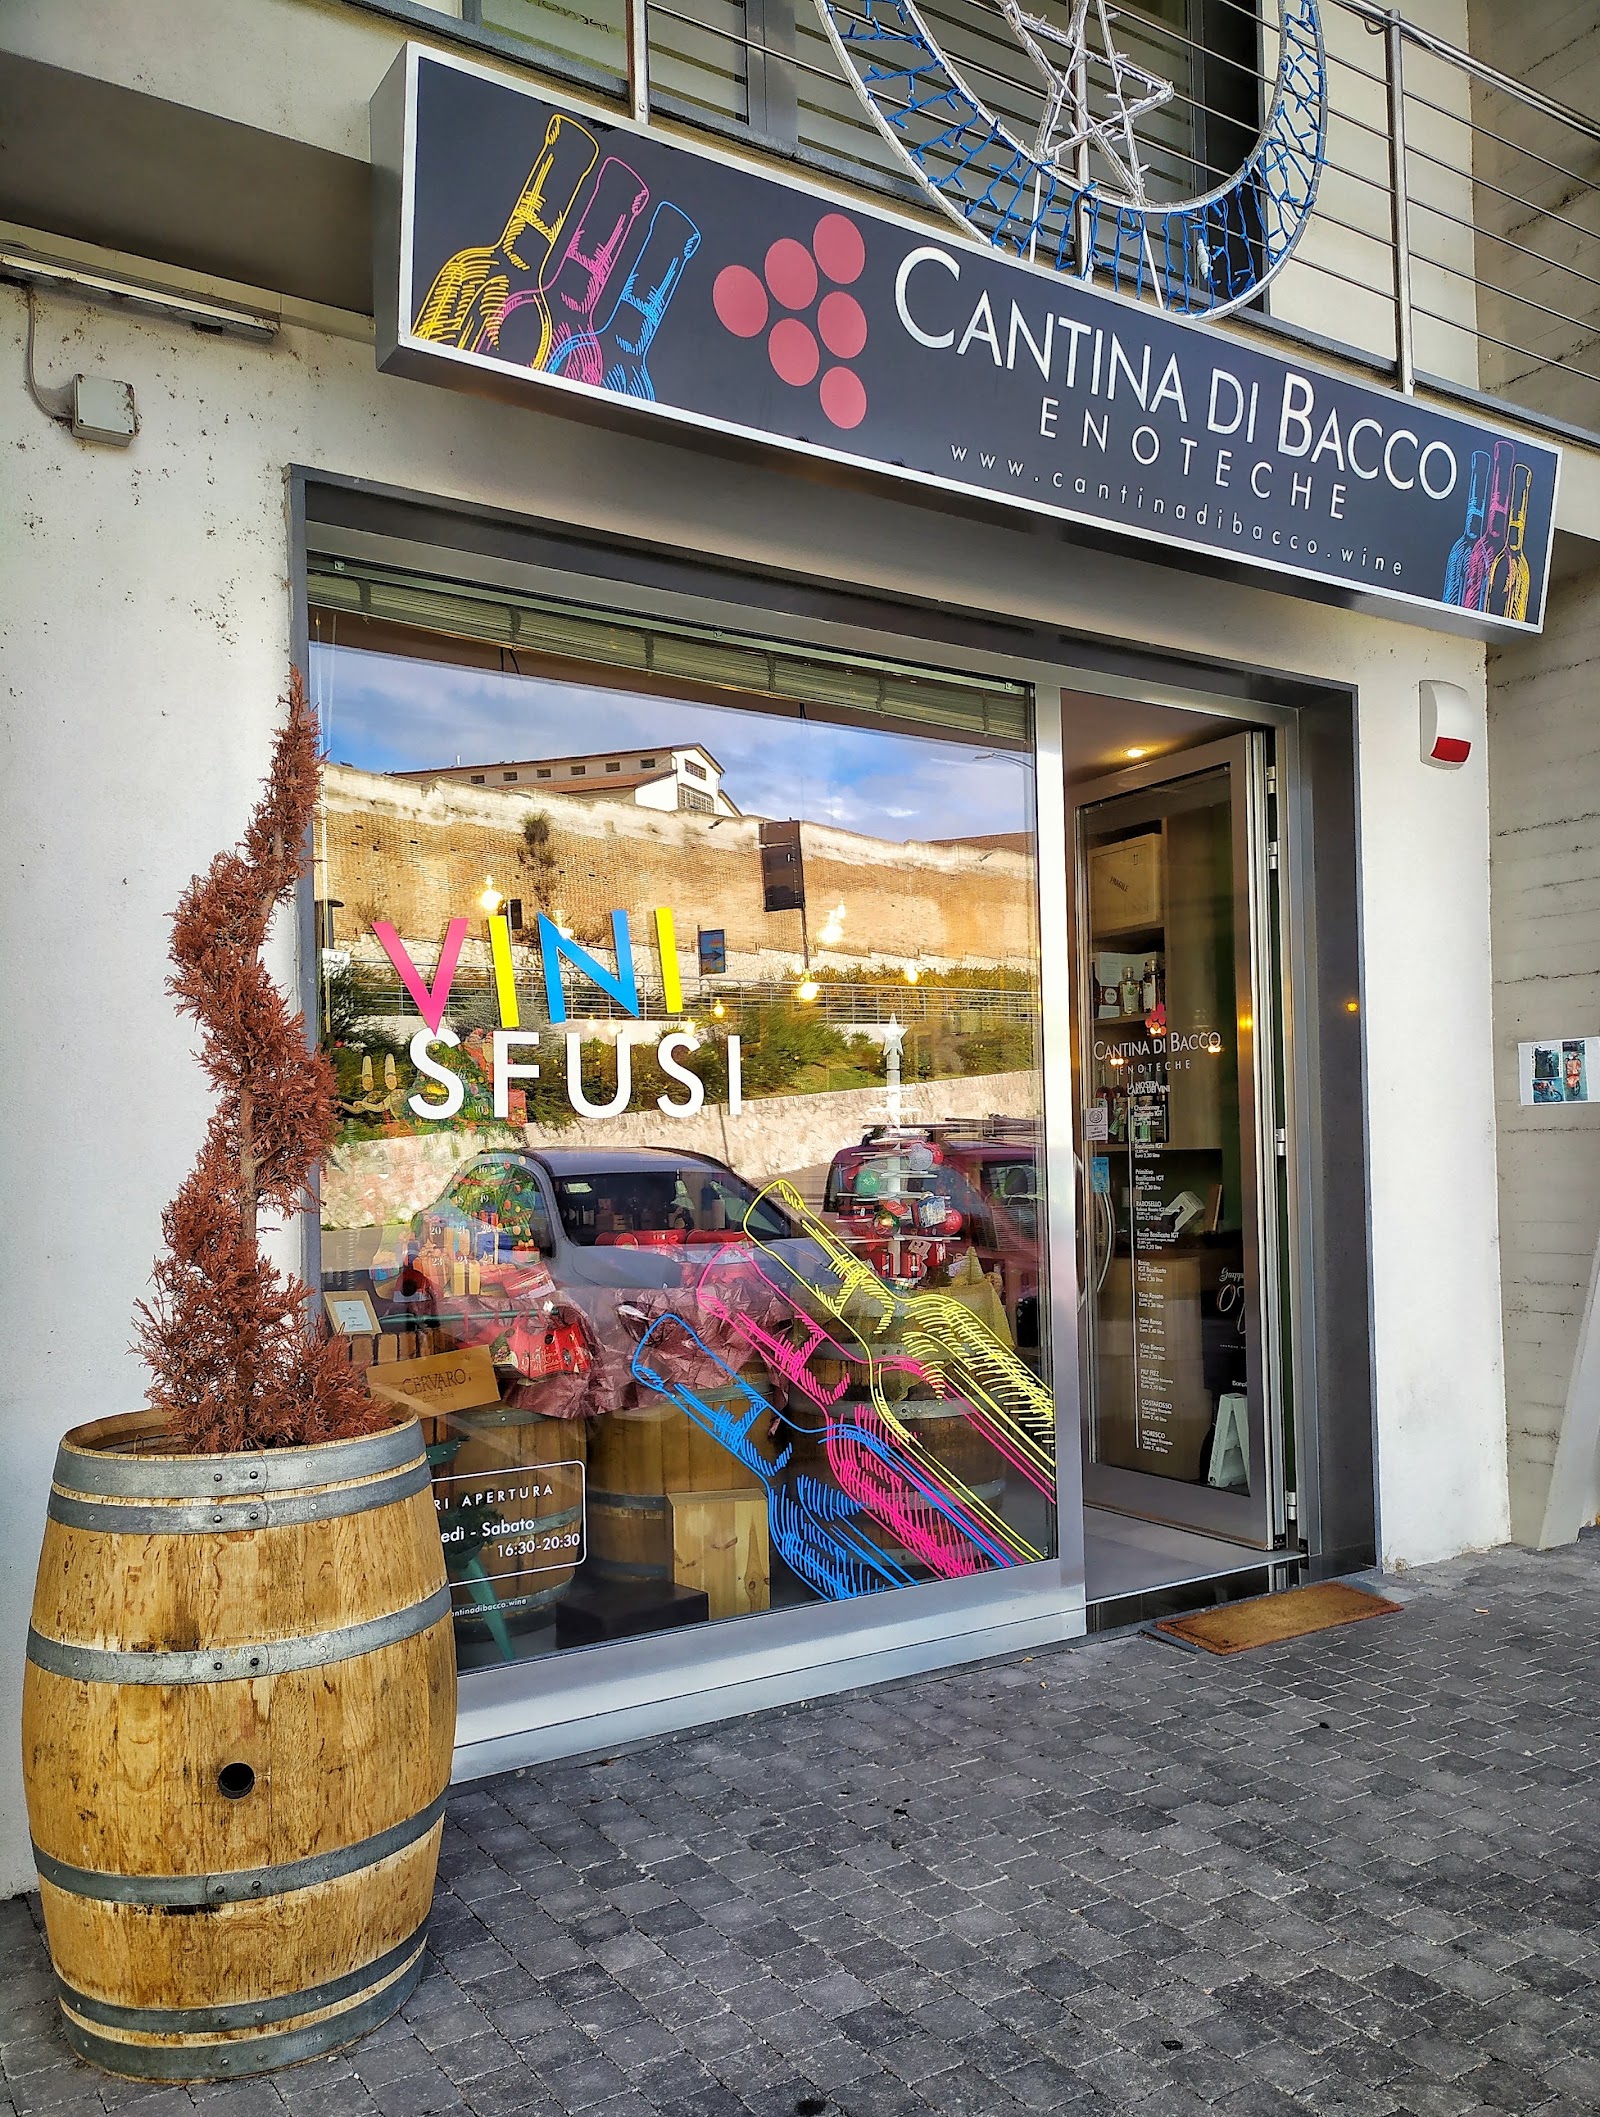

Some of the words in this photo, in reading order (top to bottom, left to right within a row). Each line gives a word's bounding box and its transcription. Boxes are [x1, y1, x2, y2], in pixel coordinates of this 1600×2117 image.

[894, 246, 1187, 423] CANTINA
[1207, 367, 1260, 443] DI
[1278, 371, 1457, 500] BACCO
[1039, 395, 1347, 521] ENOTECHE
[950, 442, 1403, 577] www.cantinadibacco.wine
[371, 907, 684, 1035] VINI
[1093, 1040, 1150, 1060] CANTINA
[1153, 1038, 1166, 1054] DI
[1170, 1032, 1222, 1052] BACCO
[407, 1026, 742, 1120] SFUSI
[1118, 1060, 1192, 1076] ENOTECHE
[429, 1226, 442, 1235] 20
[462, 1484, 554, 1508] APERTURA
[481, 1518, 535, 1538] Sabato
[497, 1532, 581, 1559] 16:30-20:30
